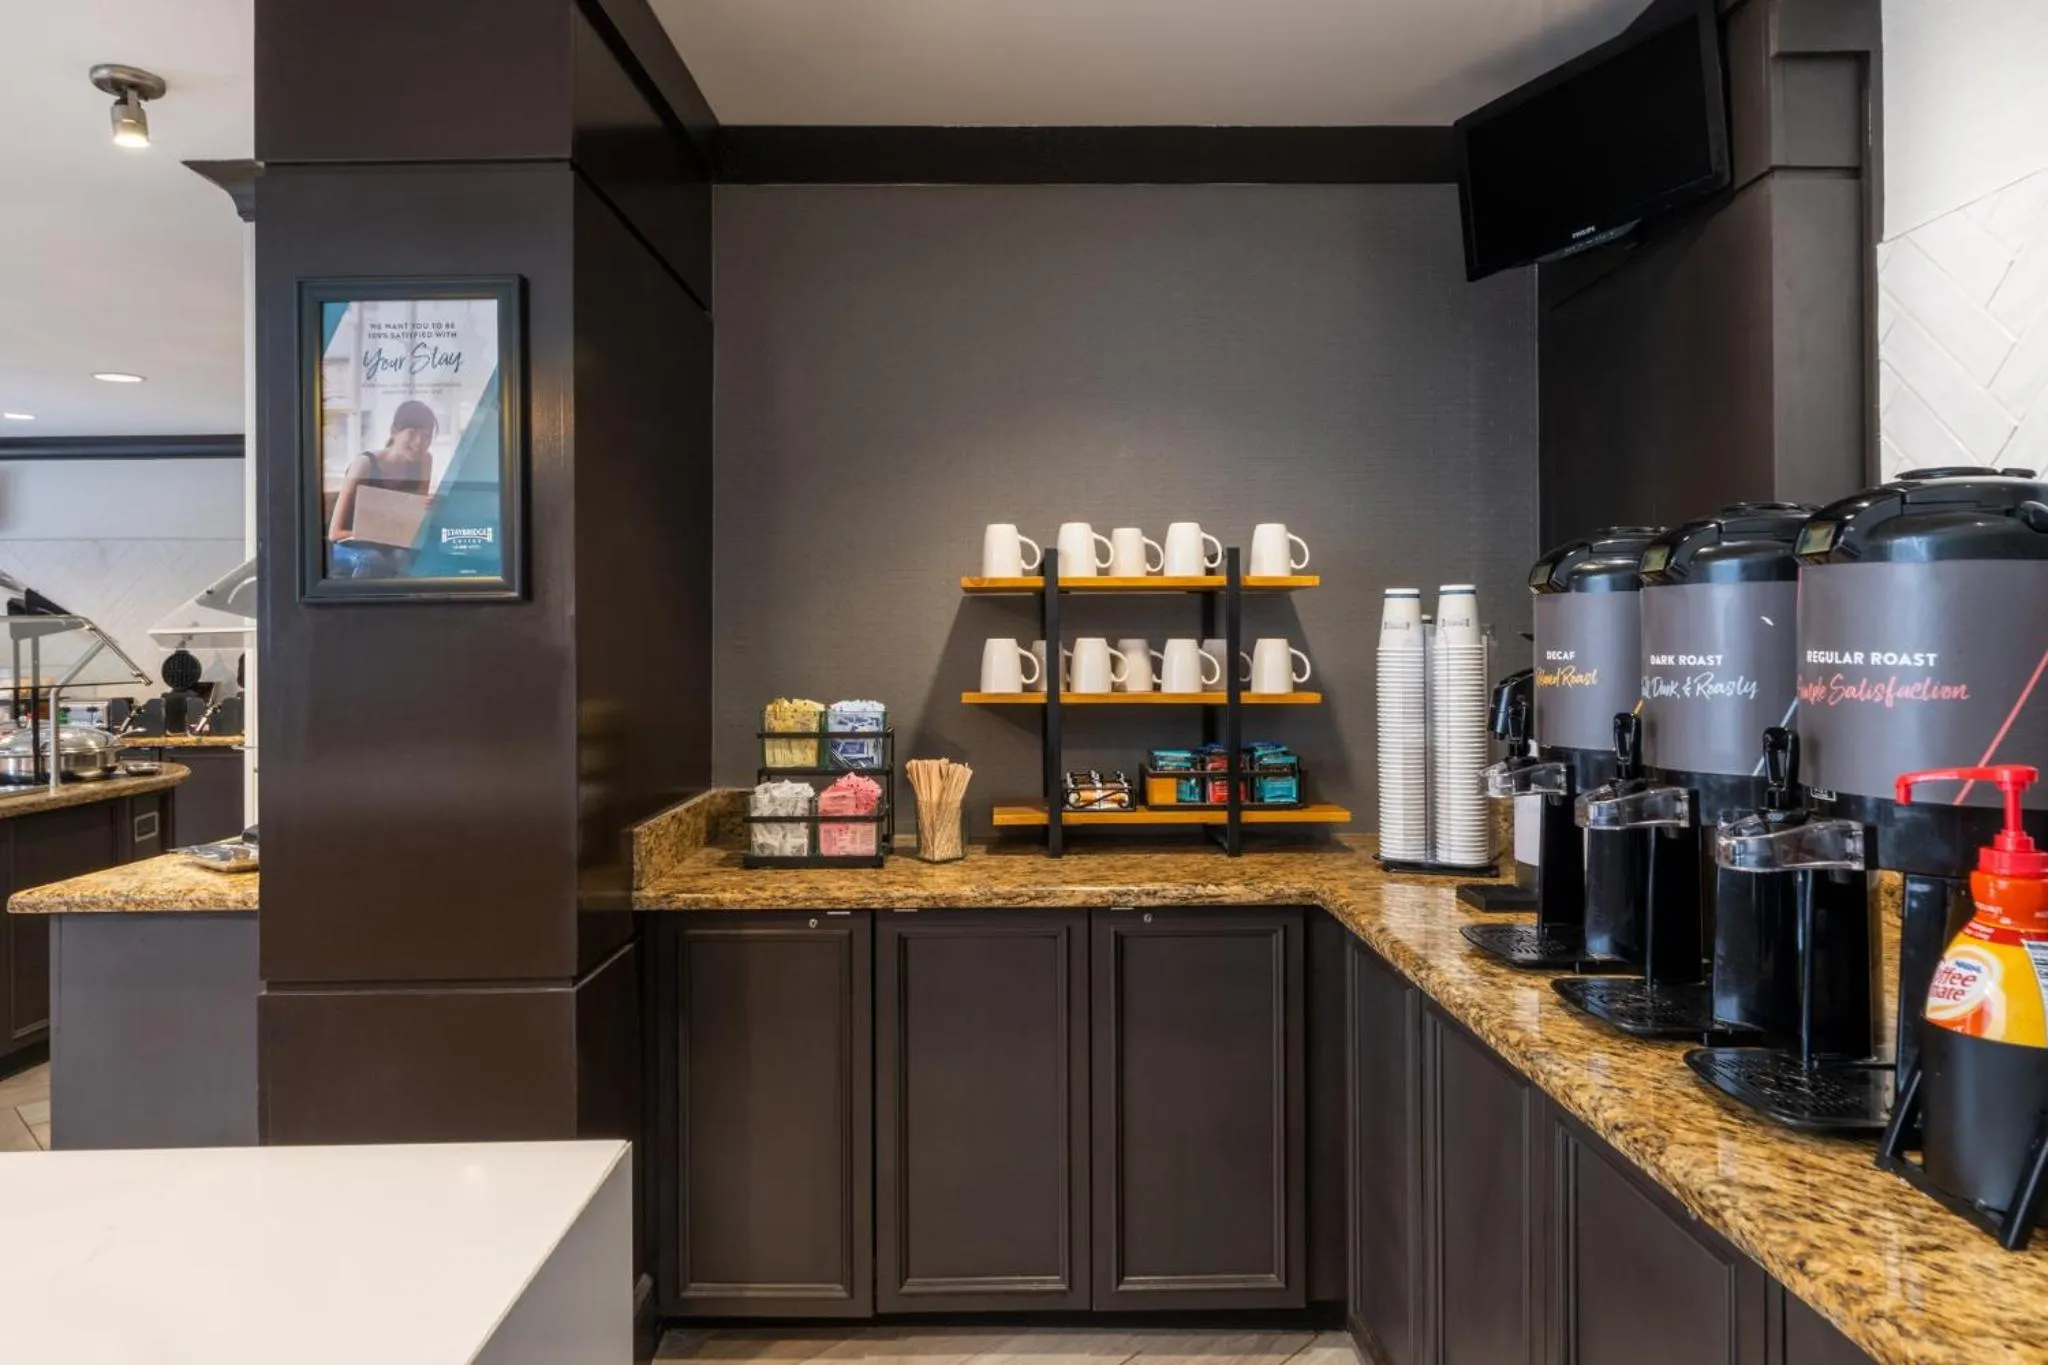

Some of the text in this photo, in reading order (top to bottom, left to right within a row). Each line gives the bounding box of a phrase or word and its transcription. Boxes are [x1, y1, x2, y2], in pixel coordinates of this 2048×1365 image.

[384, 322, 408, 330] WANT
[411, 322, 429, 330] YOU
[431, 322, 443, 330] TO
[390, 331, 433, 339] SATISFIED
[362, 341, 462, 380] Your Stay
[1546, 651, 1576, 661] DECAF
[1650, 654, 1724, 666] DARK ROAST
[1806, 650, 1938, 667] REGULAR ROAST
[1828, 673, 1970, 708] Satisfaction
